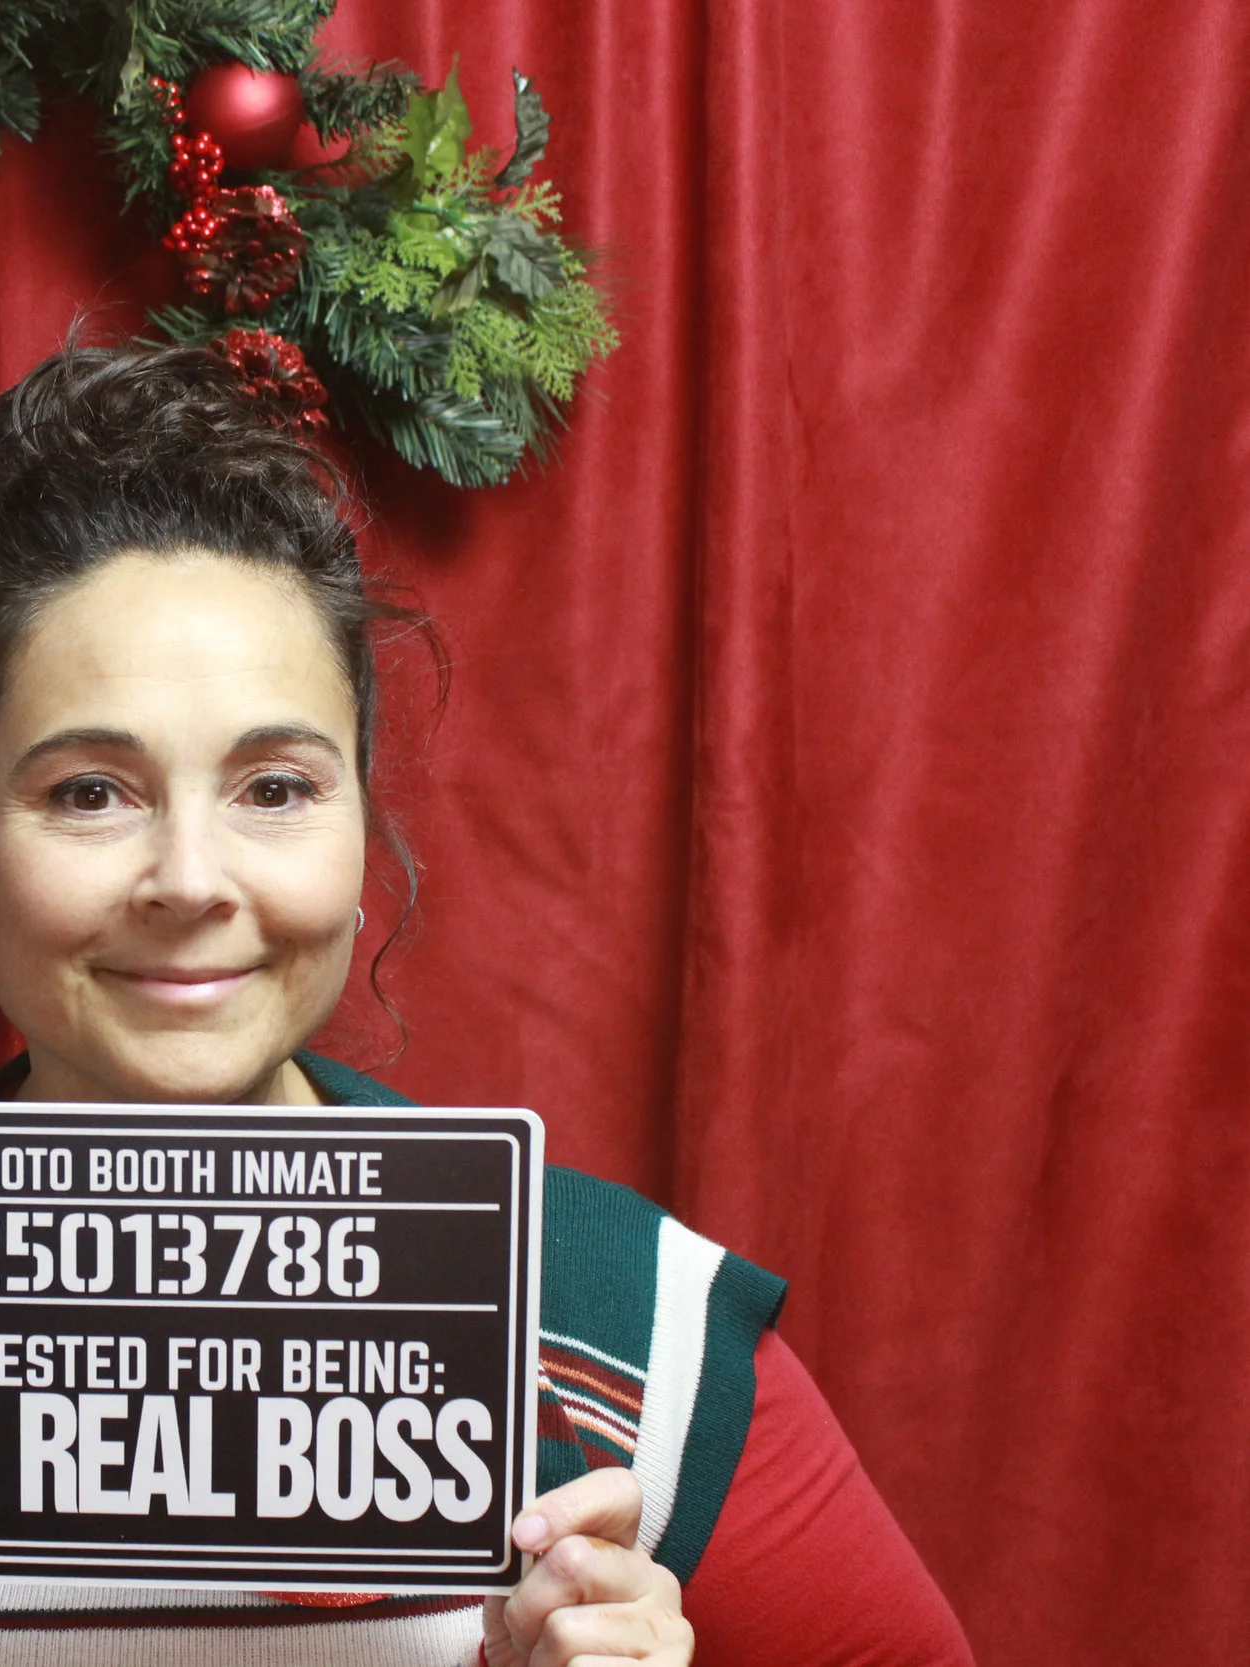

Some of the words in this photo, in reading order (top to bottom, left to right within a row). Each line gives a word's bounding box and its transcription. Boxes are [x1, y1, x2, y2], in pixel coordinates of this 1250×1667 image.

[89, 1148, 216, 1194] BOOTH
[232, 1150, 383, 1196] INMATE
[168, 1337, 262, 1392] FOR
[282, 1339, 445, 1395] BEING:
[19, 1392, 236, 1517] REAL
[256, 1396, 493, 1523] BOSS
